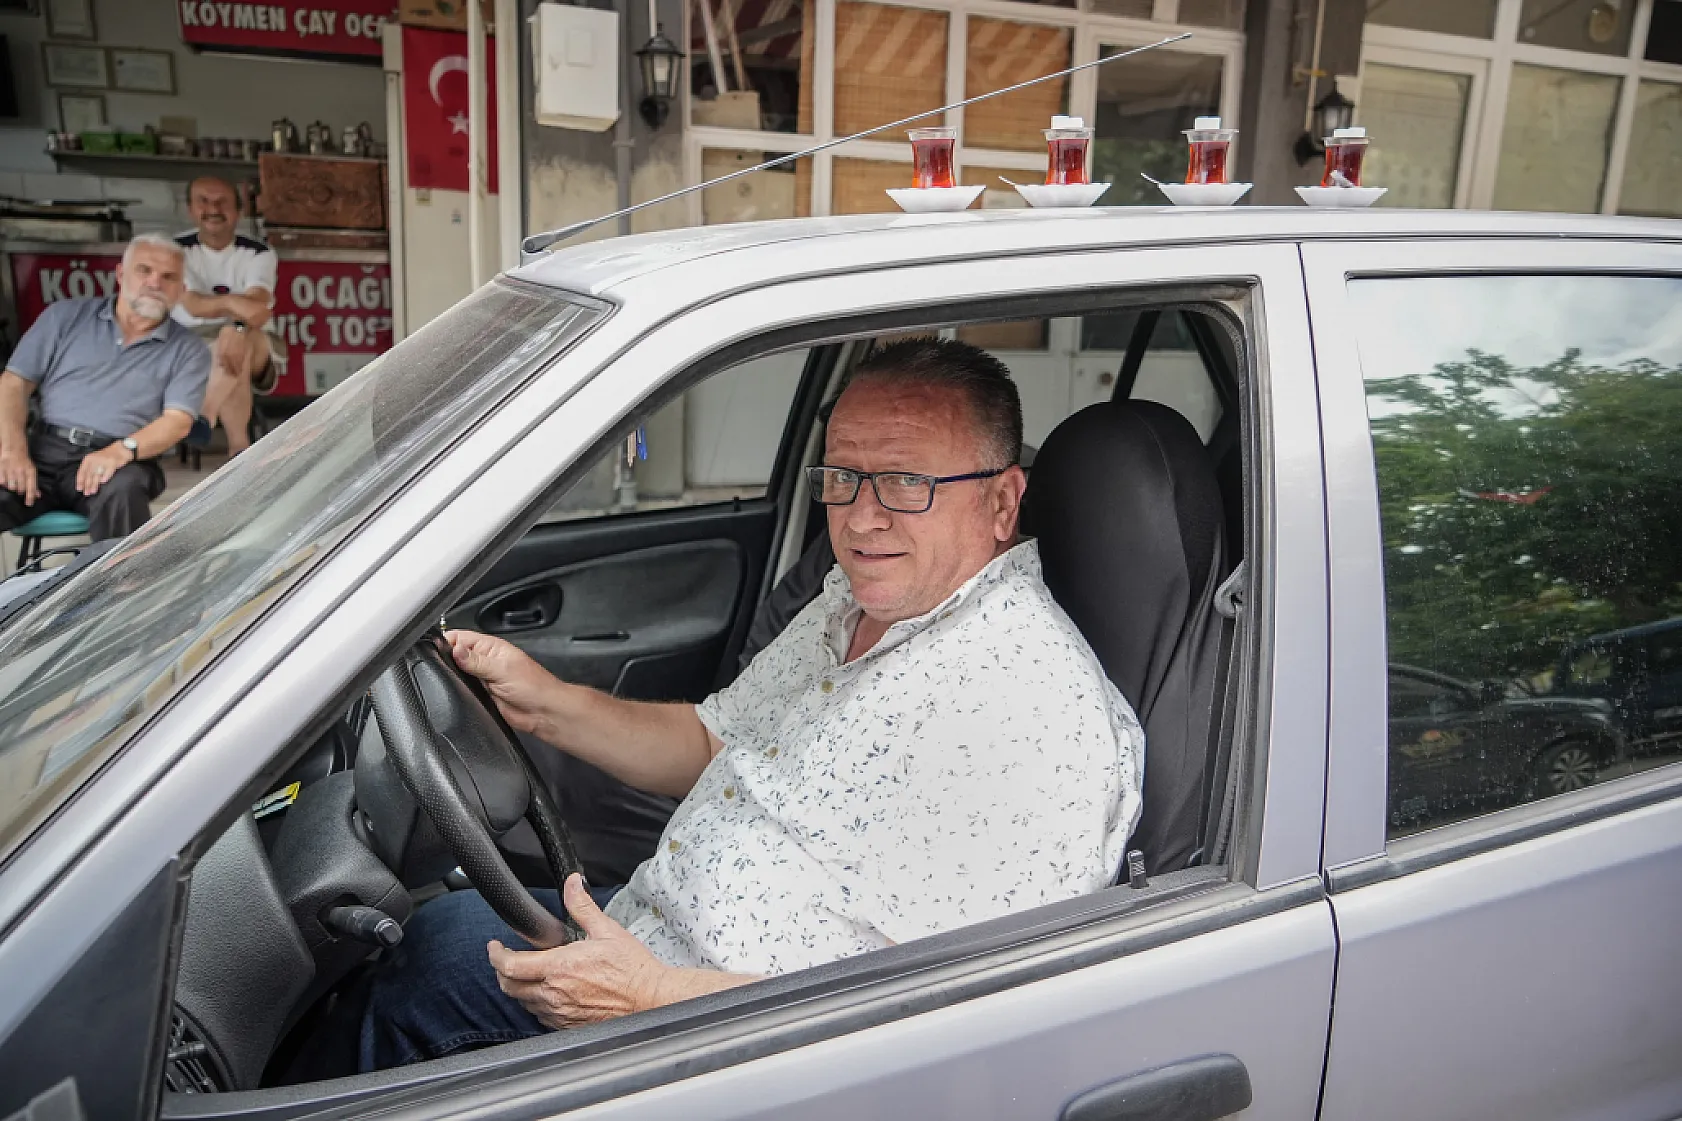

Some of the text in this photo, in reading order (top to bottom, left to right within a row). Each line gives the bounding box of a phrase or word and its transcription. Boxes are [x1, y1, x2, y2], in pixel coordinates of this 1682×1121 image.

[182, 0, 286, 31] KÖYMEN
[294, 8, 337, 38] ÇAY
[40, 260, 391, 310] KÖY OCAĞI
